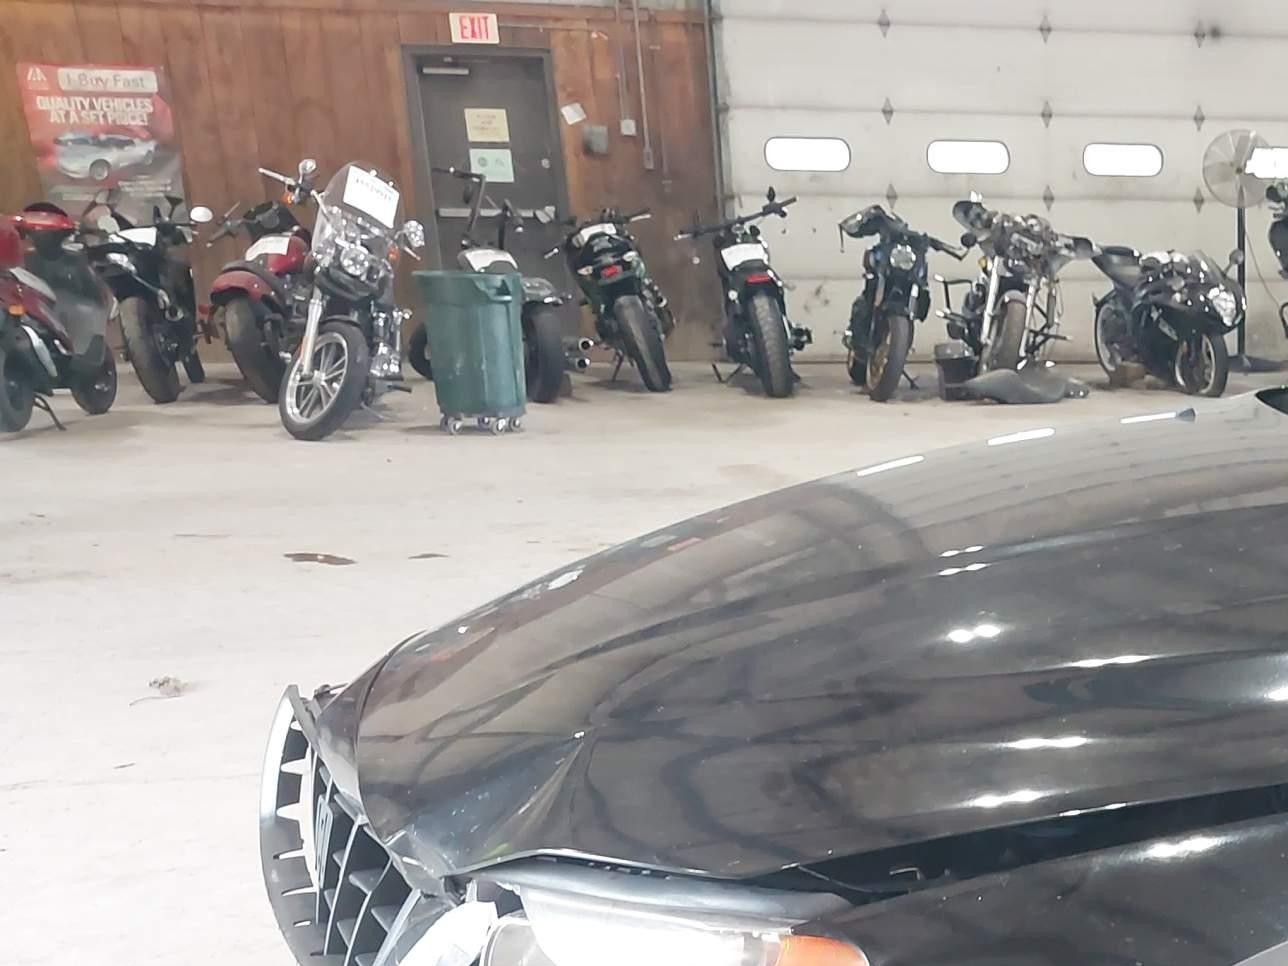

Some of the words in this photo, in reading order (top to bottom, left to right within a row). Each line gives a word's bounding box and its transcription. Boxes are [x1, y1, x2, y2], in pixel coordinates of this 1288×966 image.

[459, 15, 489, 40] EXIT
[113, 73, 145, 88] Fast
[36, 95, 94, 111] QUALITY
[95, 97, 154, 113] VEHICLES
[50, 110, 66, 124] AT
[69, 110, 80, 125] A
[81, 110, 105, 125] SET
